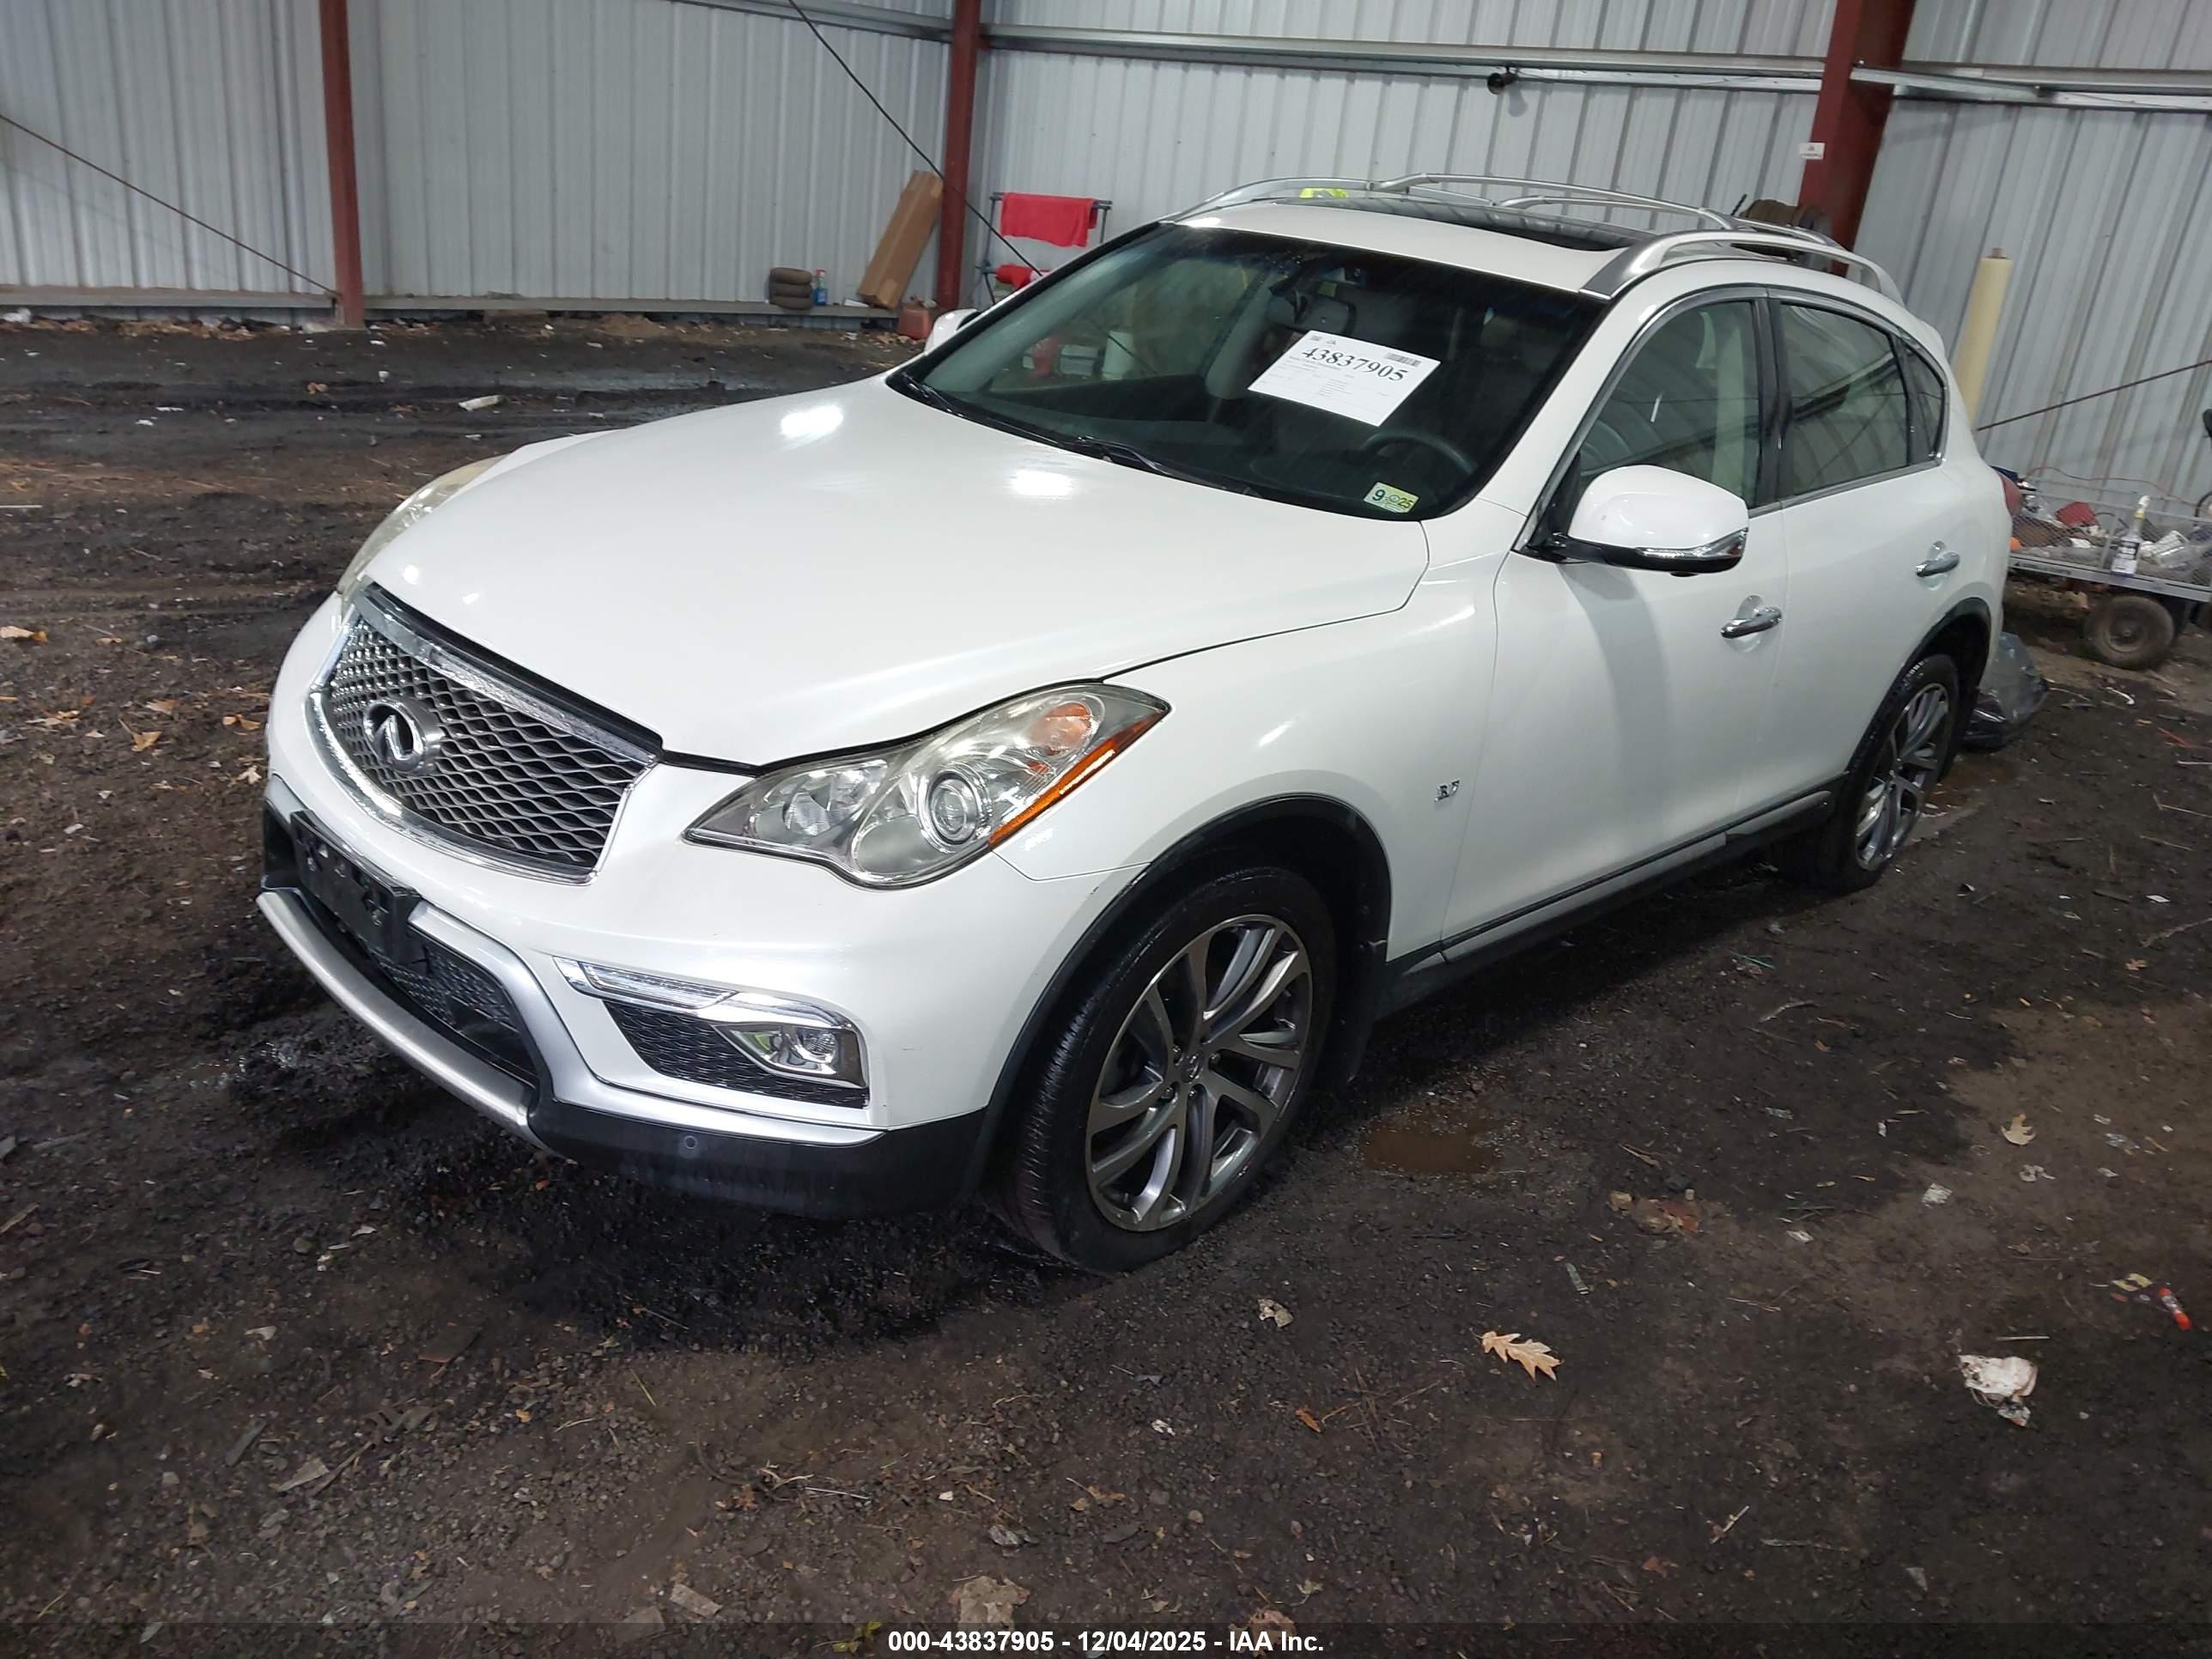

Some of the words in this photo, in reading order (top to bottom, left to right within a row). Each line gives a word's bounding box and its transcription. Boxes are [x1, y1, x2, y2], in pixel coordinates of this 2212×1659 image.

[1302, 347, 1408, 382] 43837905
[1372, 489, 1386, 501] 9
[1397, 497, 1413, 509] 25
